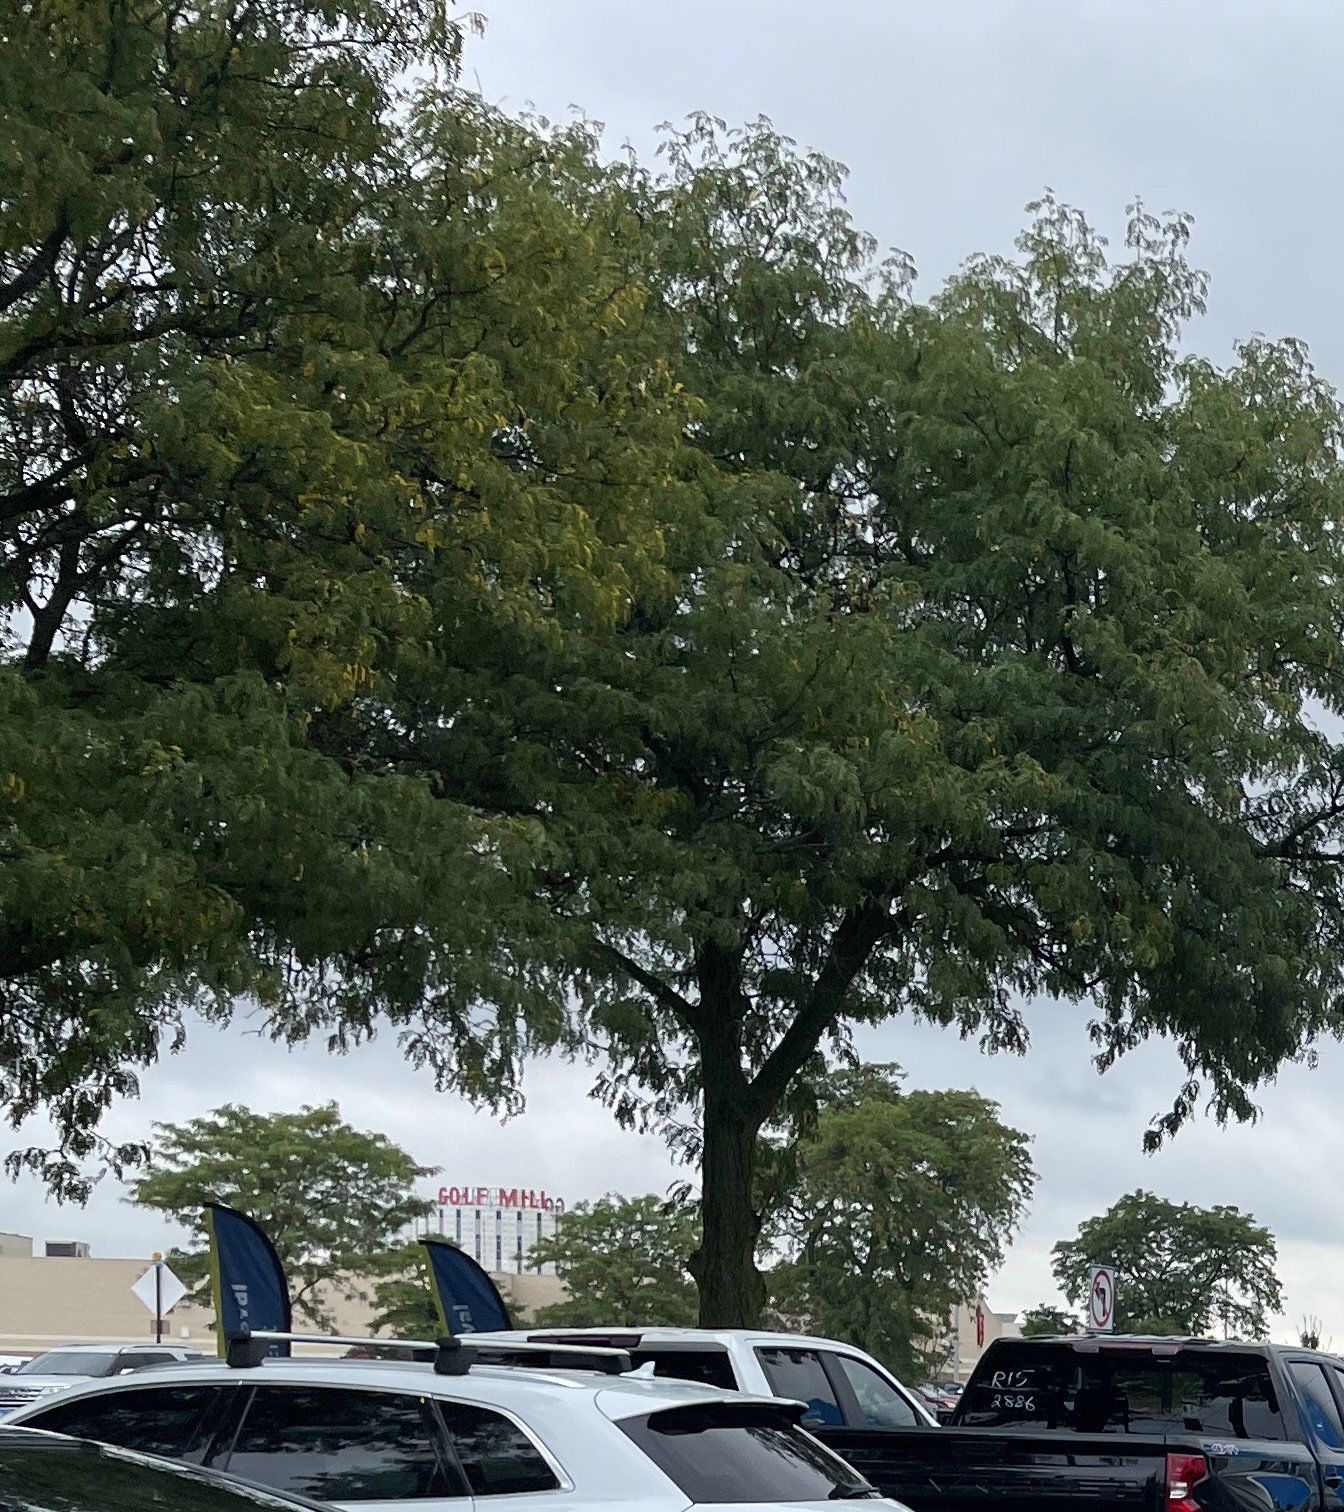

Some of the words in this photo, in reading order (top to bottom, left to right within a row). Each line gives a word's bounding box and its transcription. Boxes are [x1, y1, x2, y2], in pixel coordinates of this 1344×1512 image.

[438, 1186, 488, 1206] GOLF
[498, 1188, 550, 1210] MILL
[991, 1394, 1036, 1412] 2886
